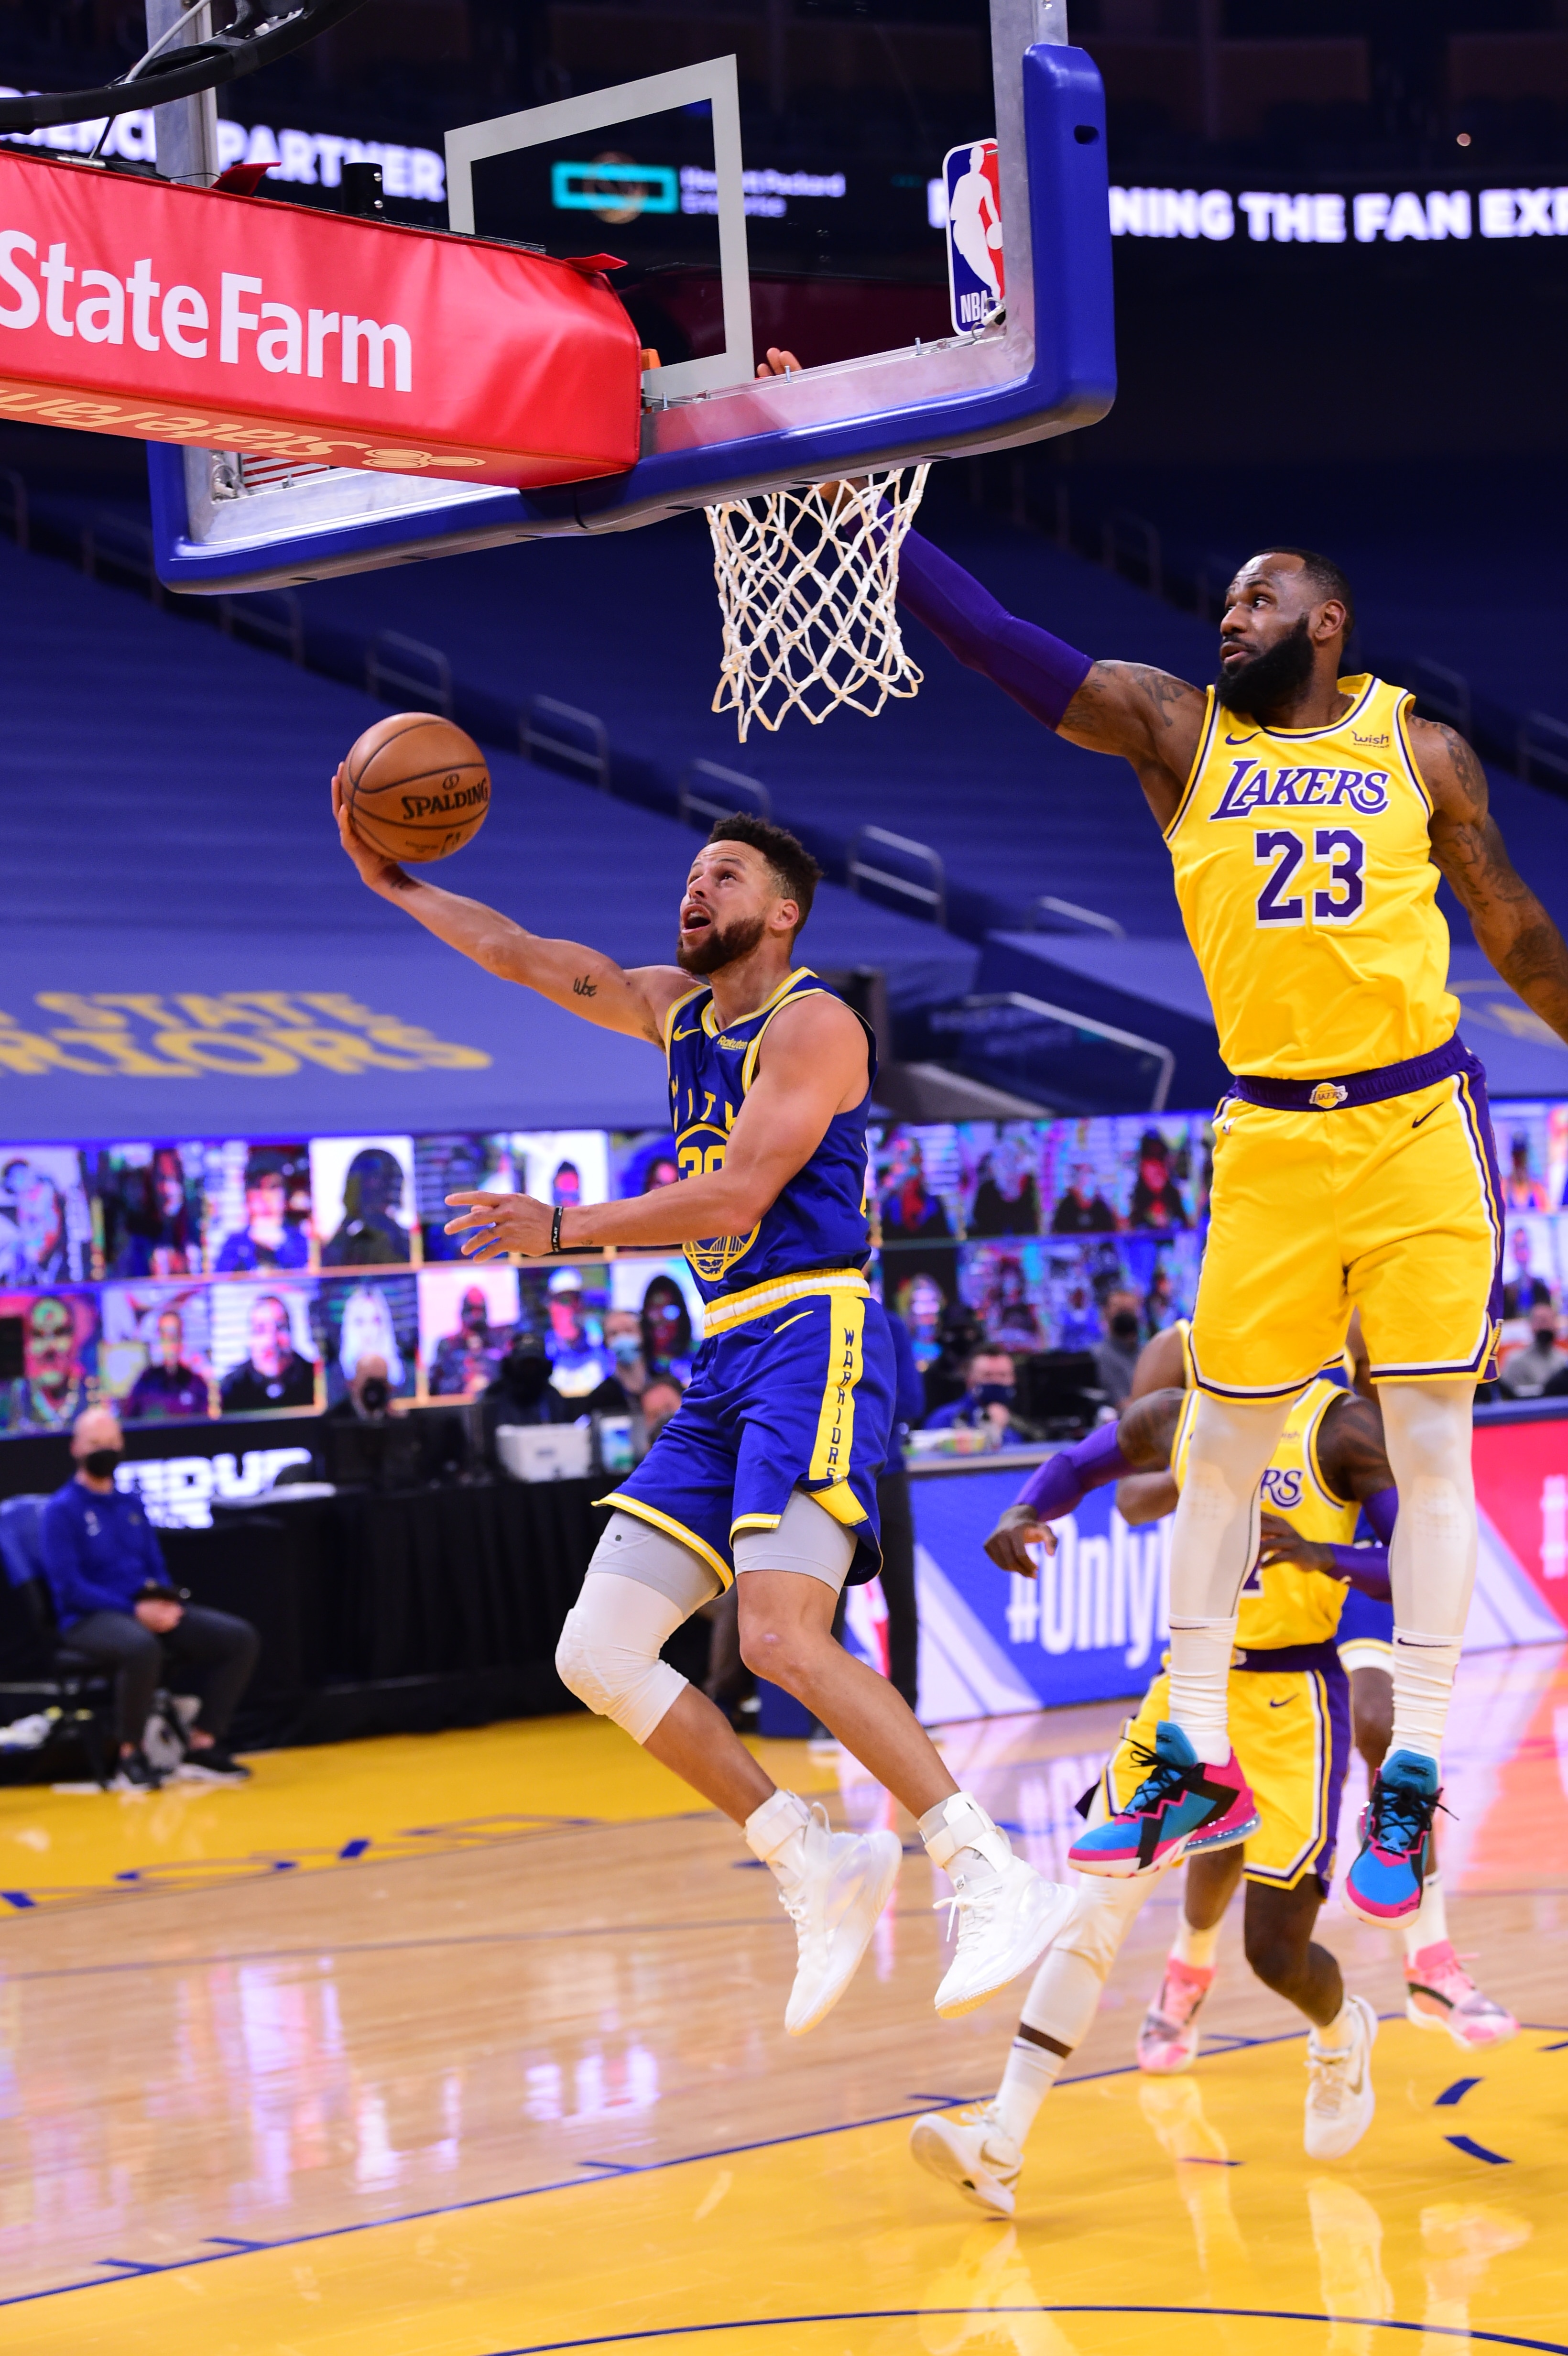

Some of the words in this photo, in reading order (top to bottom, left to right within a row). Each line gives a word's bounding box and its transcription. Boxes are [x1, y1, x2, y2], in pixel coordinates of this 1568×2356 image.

[1108, 185, 1235, 240] NING
[1238, 191, 1346, 243] THE
[1353, 190, 1472, 242] FAN
[0, 230, 209, 359] State
[219, 272, 412, 392] Farm
[960, 290, 990, 323] NBA
[135, 417, 372, 457] State
[401, 776, 488, 820] SPALDING
[1208, 757, 1391, 823] LAKERS
[1254, 827, 1366, 929] 23
[0, 1028, 491, 1077] RIORS
[717, 1035, 748, 1049] Rakuten
[1260, 1468, 1303, 1508] RS
